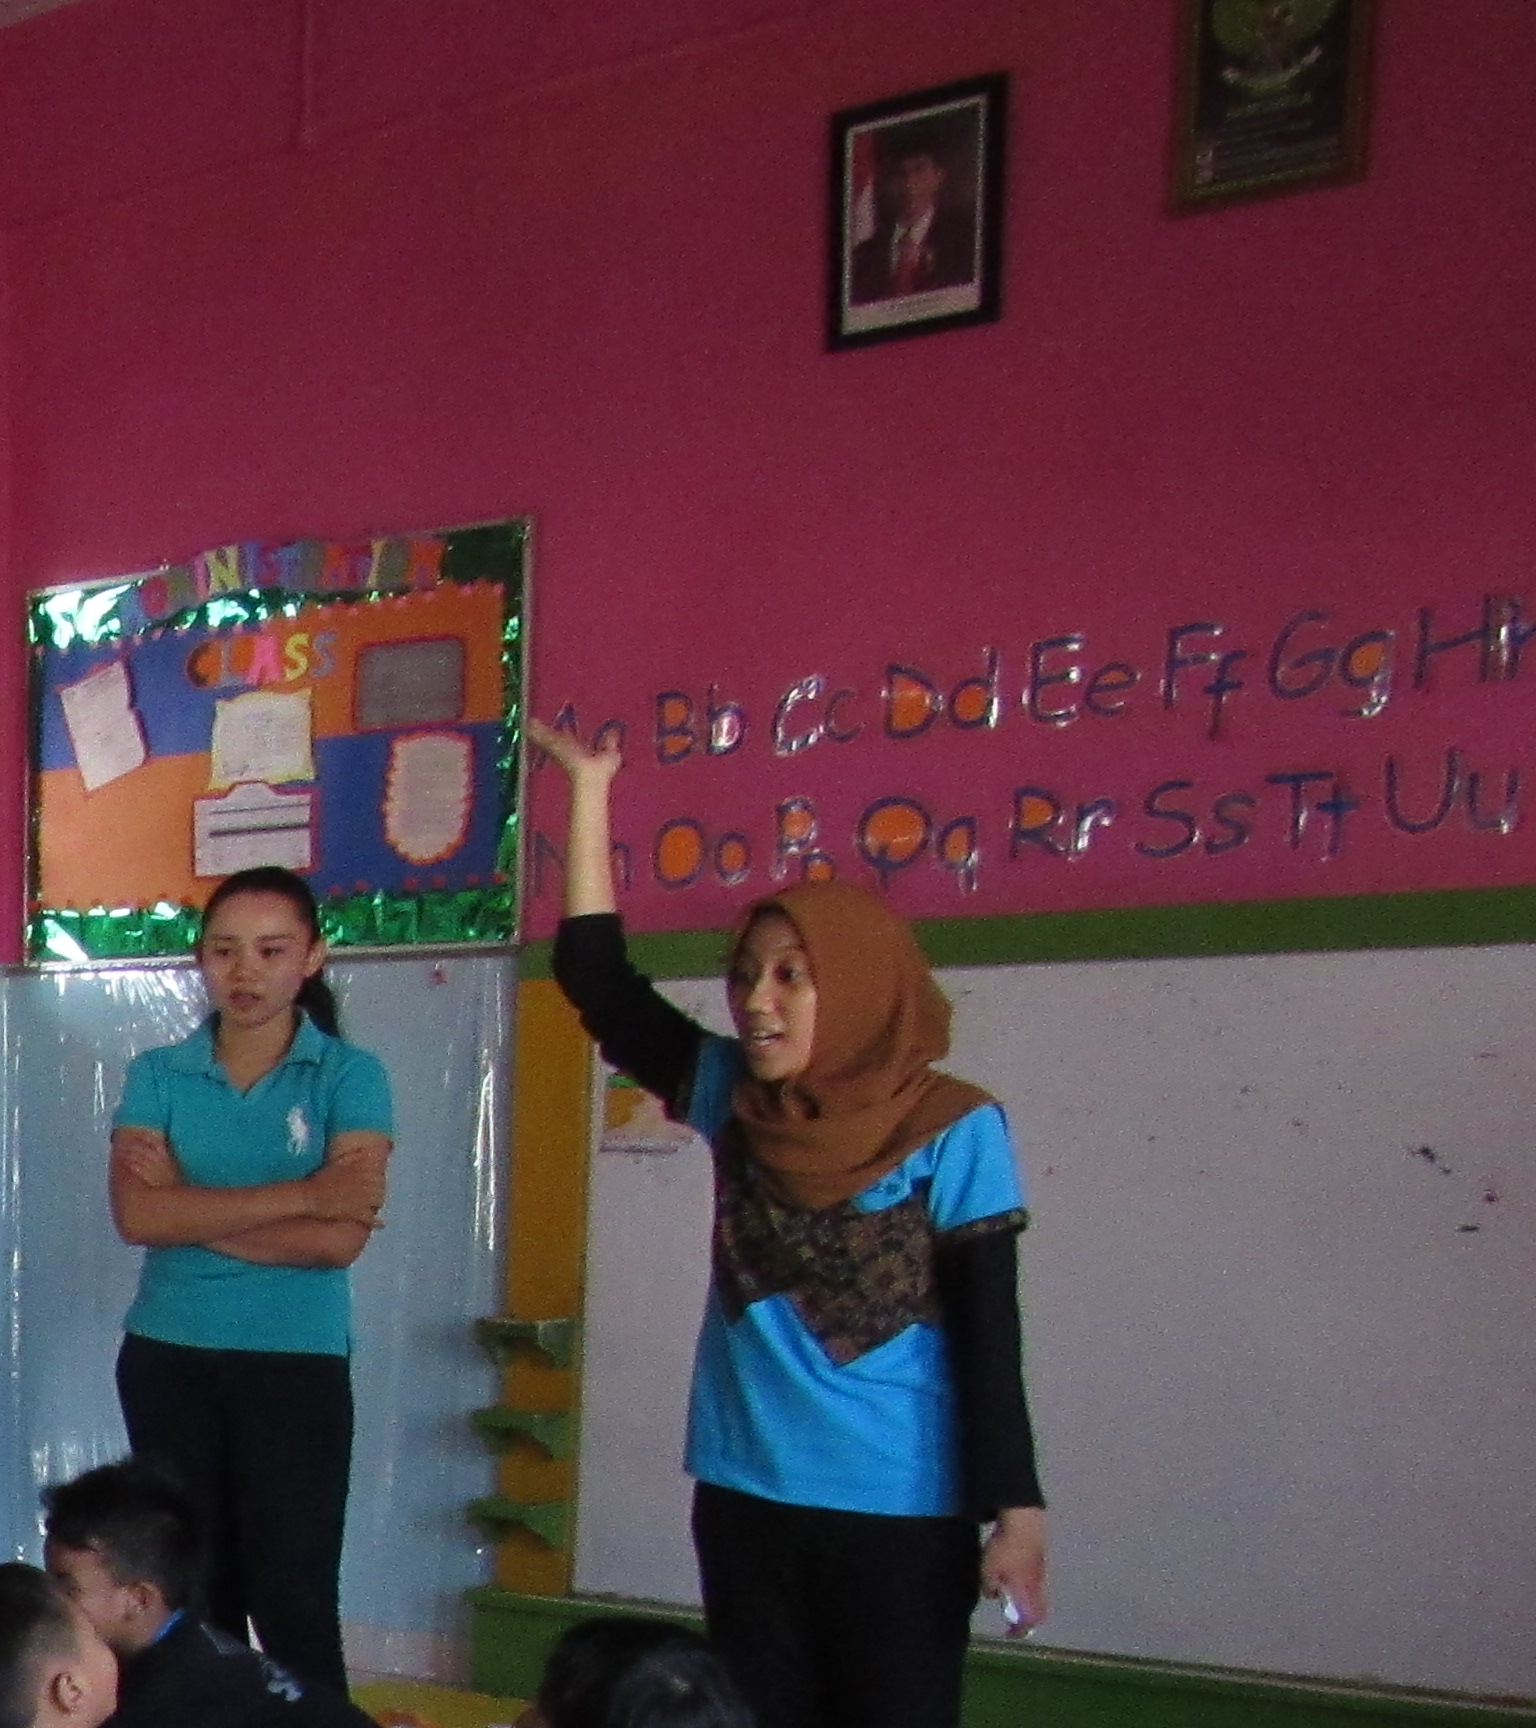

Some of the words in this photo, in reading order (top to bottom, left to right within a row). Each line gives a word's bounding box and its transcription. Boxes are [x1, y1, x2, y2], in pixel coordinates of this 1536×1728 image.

[186, 631, 338, 691] CLASS
[657, 682, 745, 764] Bb
[773, 673, 864, 756] Cc
[880, 646, 1001, 740] Dd
[1022, 632, 1141, 729] Ee
[1160, 622, 1246, 739] Ff
[1269, 610, 1395, 717] Gg
[654, 817, 753, 888] Oo
[855, 796, 979, 893] Qq
[1008, 785, 1116, 862] Rr
[1135, 779, 1258, 858] Ss
[1265, 771, 1361, 858] Tt
[1384, 747, 1521, 835] Uu
